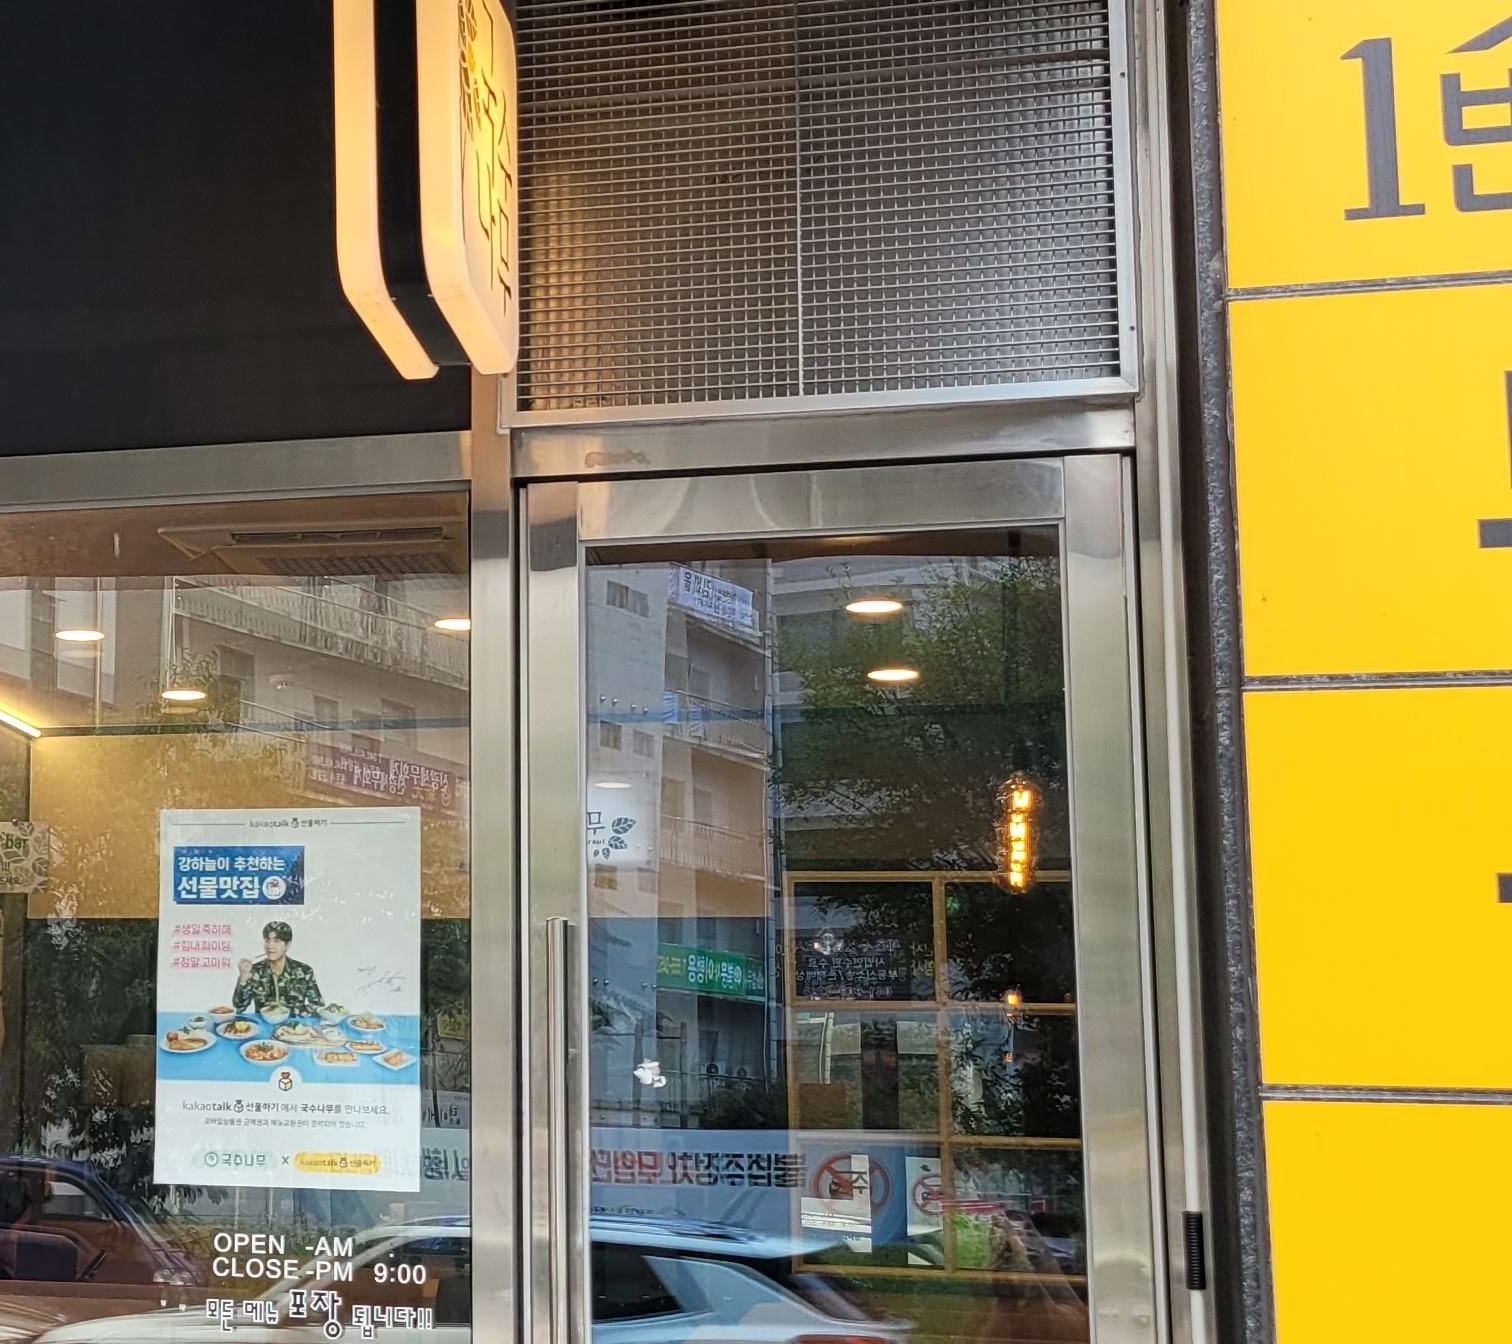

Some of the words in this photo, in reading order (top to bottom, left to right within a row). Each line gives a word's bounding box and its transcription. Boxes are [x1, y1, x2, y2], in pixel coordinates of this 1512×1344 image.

[177, 856, 230, 872] 강하늘이
[233, 856, 287, 872] 추천하는
[176, 875, 260, 900] 선물맛집
[173, 956, 200, 969] #정말
[201, 956, 231, 969] 고마워
[182, 1100, 232, 1113] kakaotalk
[300, 1103, 342, 1114] 국수나무를
[221, 1153, 266, 1167] 국수나무
[213, 1232, 286, 1255] OPEN
[305, 1236, 354, 1258] -AM
[212, 1256, 299, 1280] CLOSE
[305, 1260, 353, 1282] -PM
[374, 1262, 427, 1285] 9:00
[205, 1298, 234, 1333] 모든
[242, 1299, 279, 1325] 메뉴
[288, 1288, 342, 1340] 포장
[351, 1303, 433, 1340] 됩니다!!
